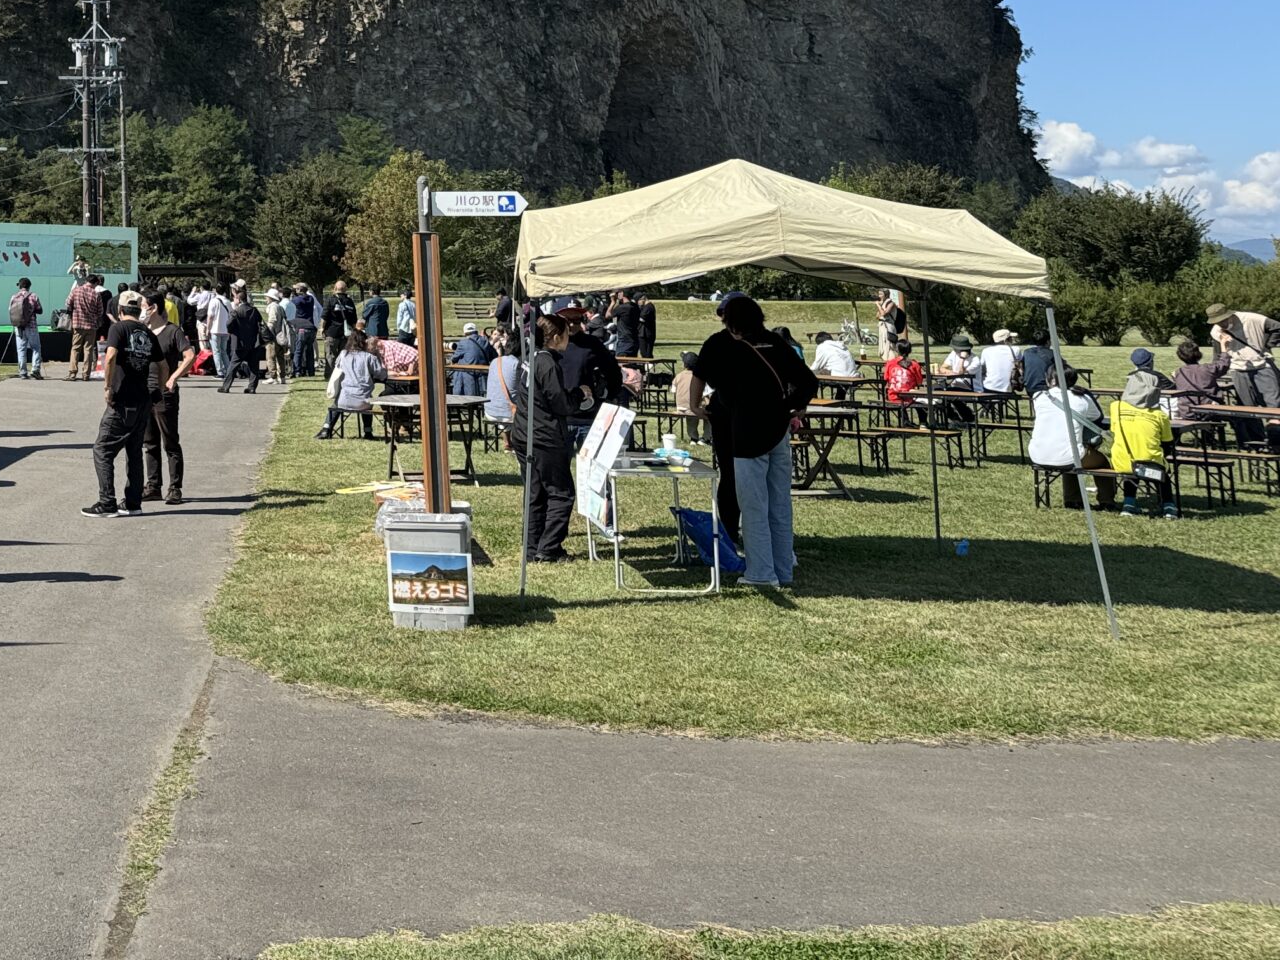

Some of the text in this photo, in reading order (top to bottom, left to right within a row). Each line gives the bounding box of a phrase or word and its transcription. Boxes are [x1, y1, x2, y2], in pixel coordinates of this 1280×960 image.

[456, 194, 495, 207] 川の駅
[394, 580, 468, 600] 燃えるゴミ
